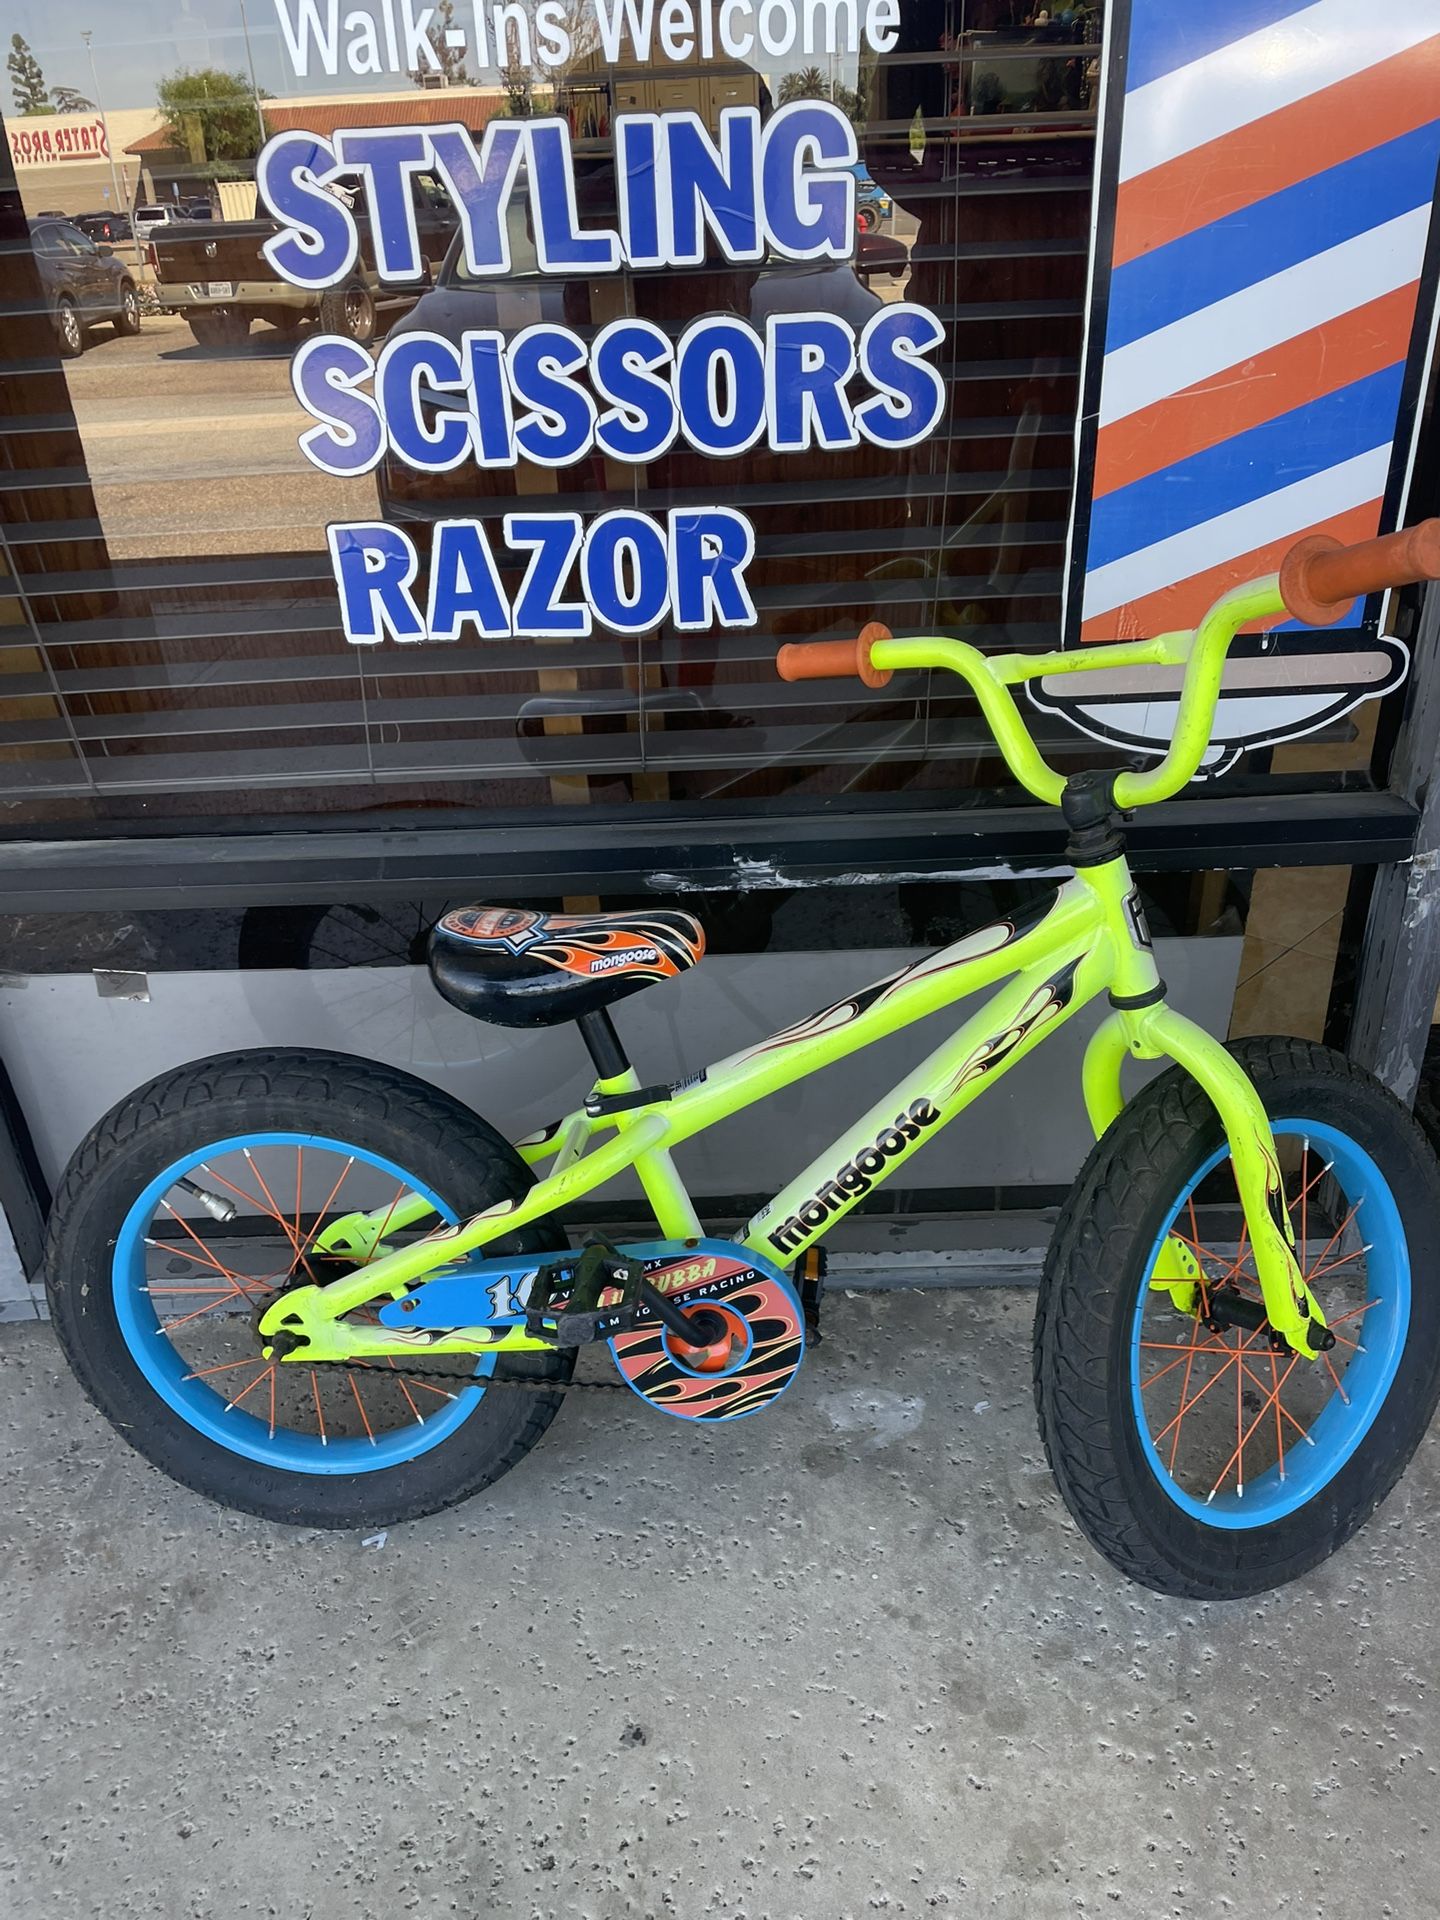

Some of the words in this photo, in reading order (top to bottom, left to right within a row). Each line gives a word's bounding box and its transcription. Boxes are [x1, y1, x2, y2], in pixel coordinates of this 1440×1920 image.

[272, 0, 571, 76] Walk-Ins
[595, 0, 901, 62] Welcome
[257, 100, 857, 289] STYLING
[294, 302, 946, 476] SCISSORS
[326, 506, 758, 645] RAZOR
[591, 949, 656, 972] mongoose
[767, 1097, 941, 1255] mongoose
[699, 1270, 755, 1296] RACING
